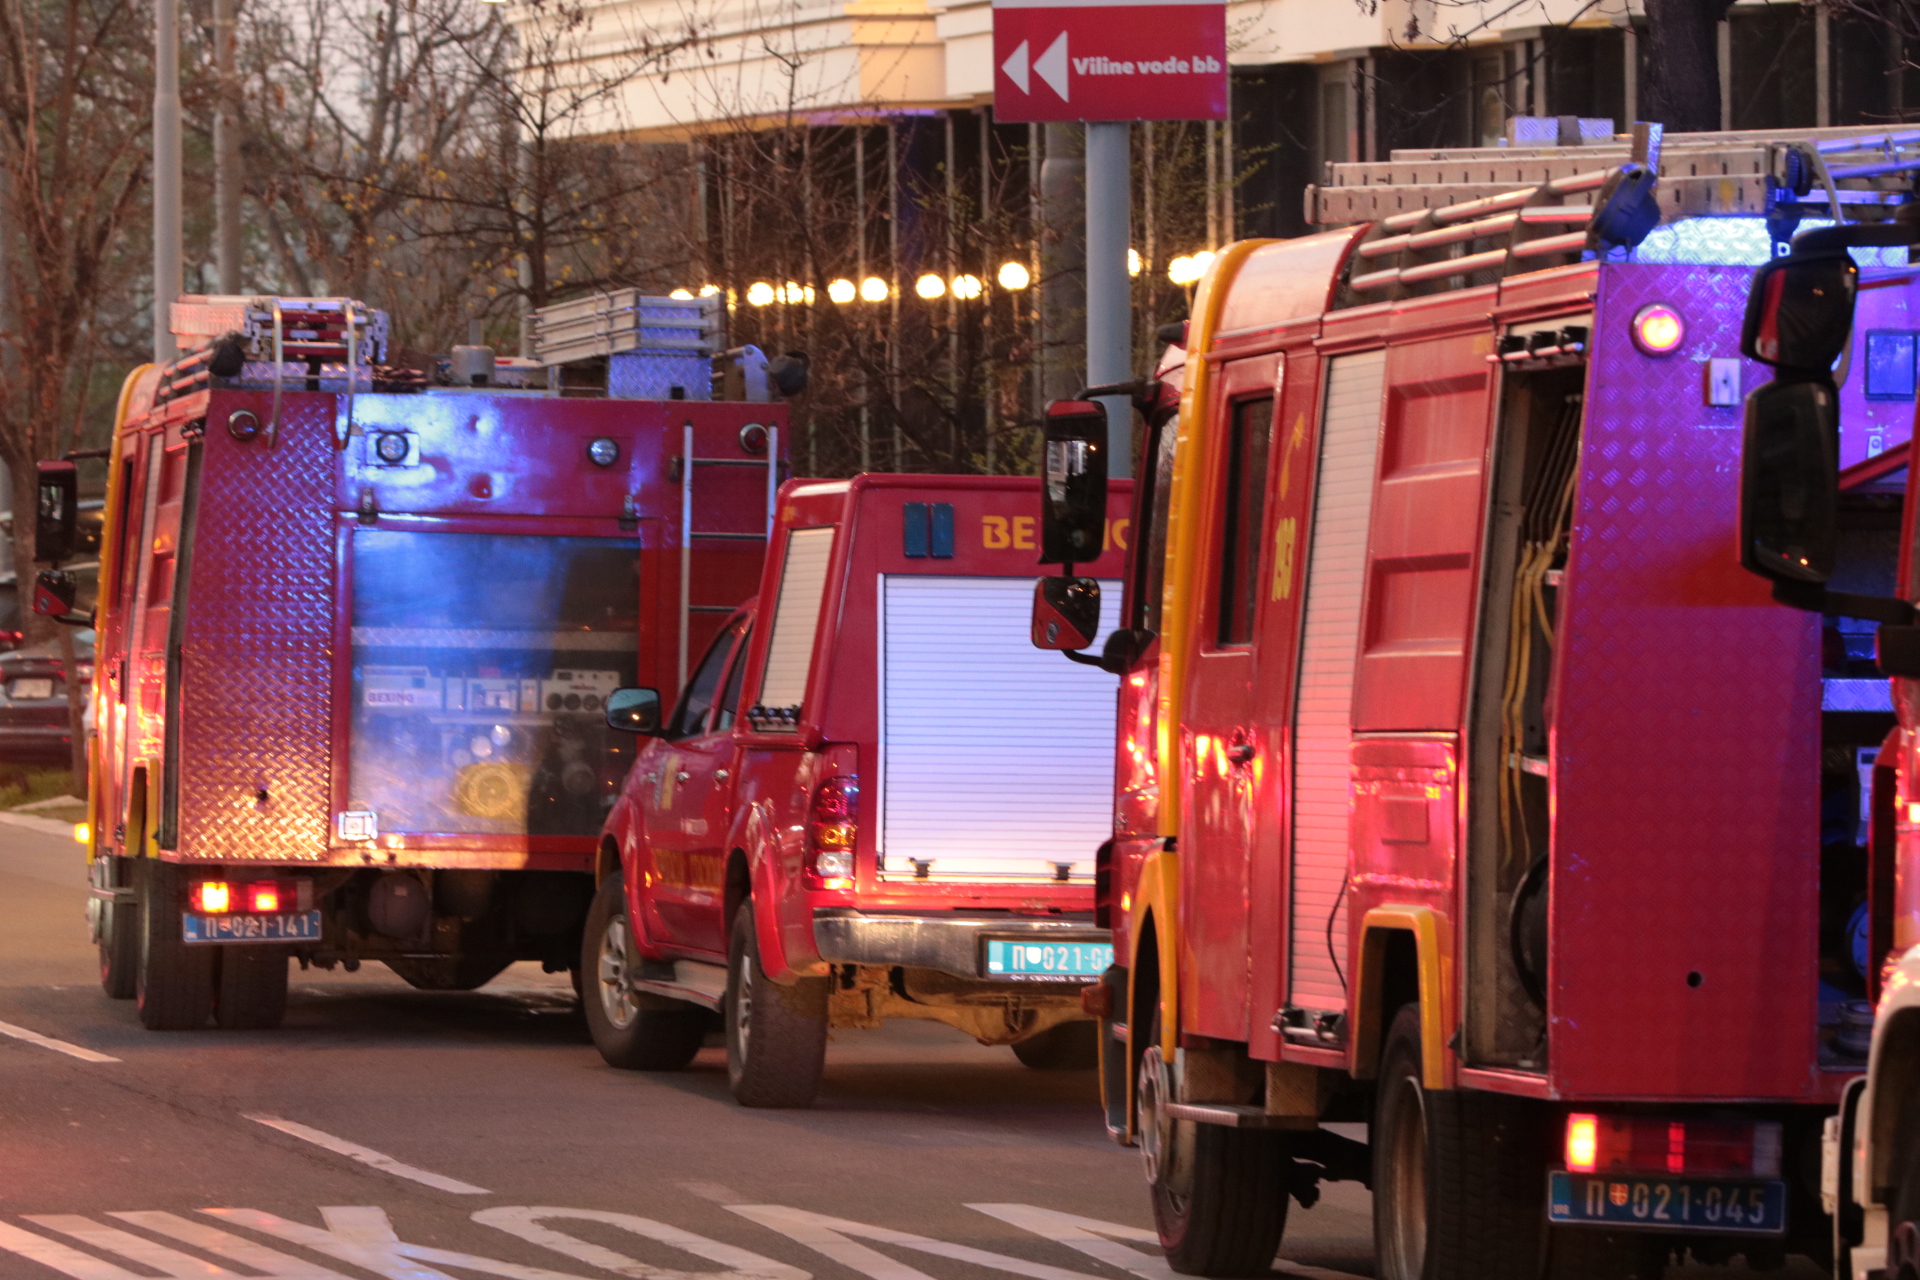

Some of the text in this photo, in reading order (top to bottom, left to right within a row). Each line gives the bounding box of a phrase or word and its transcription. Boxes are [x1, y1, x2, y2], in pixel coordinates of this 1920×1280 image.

[1072, 55, 1221, 75] Viline vode bb
